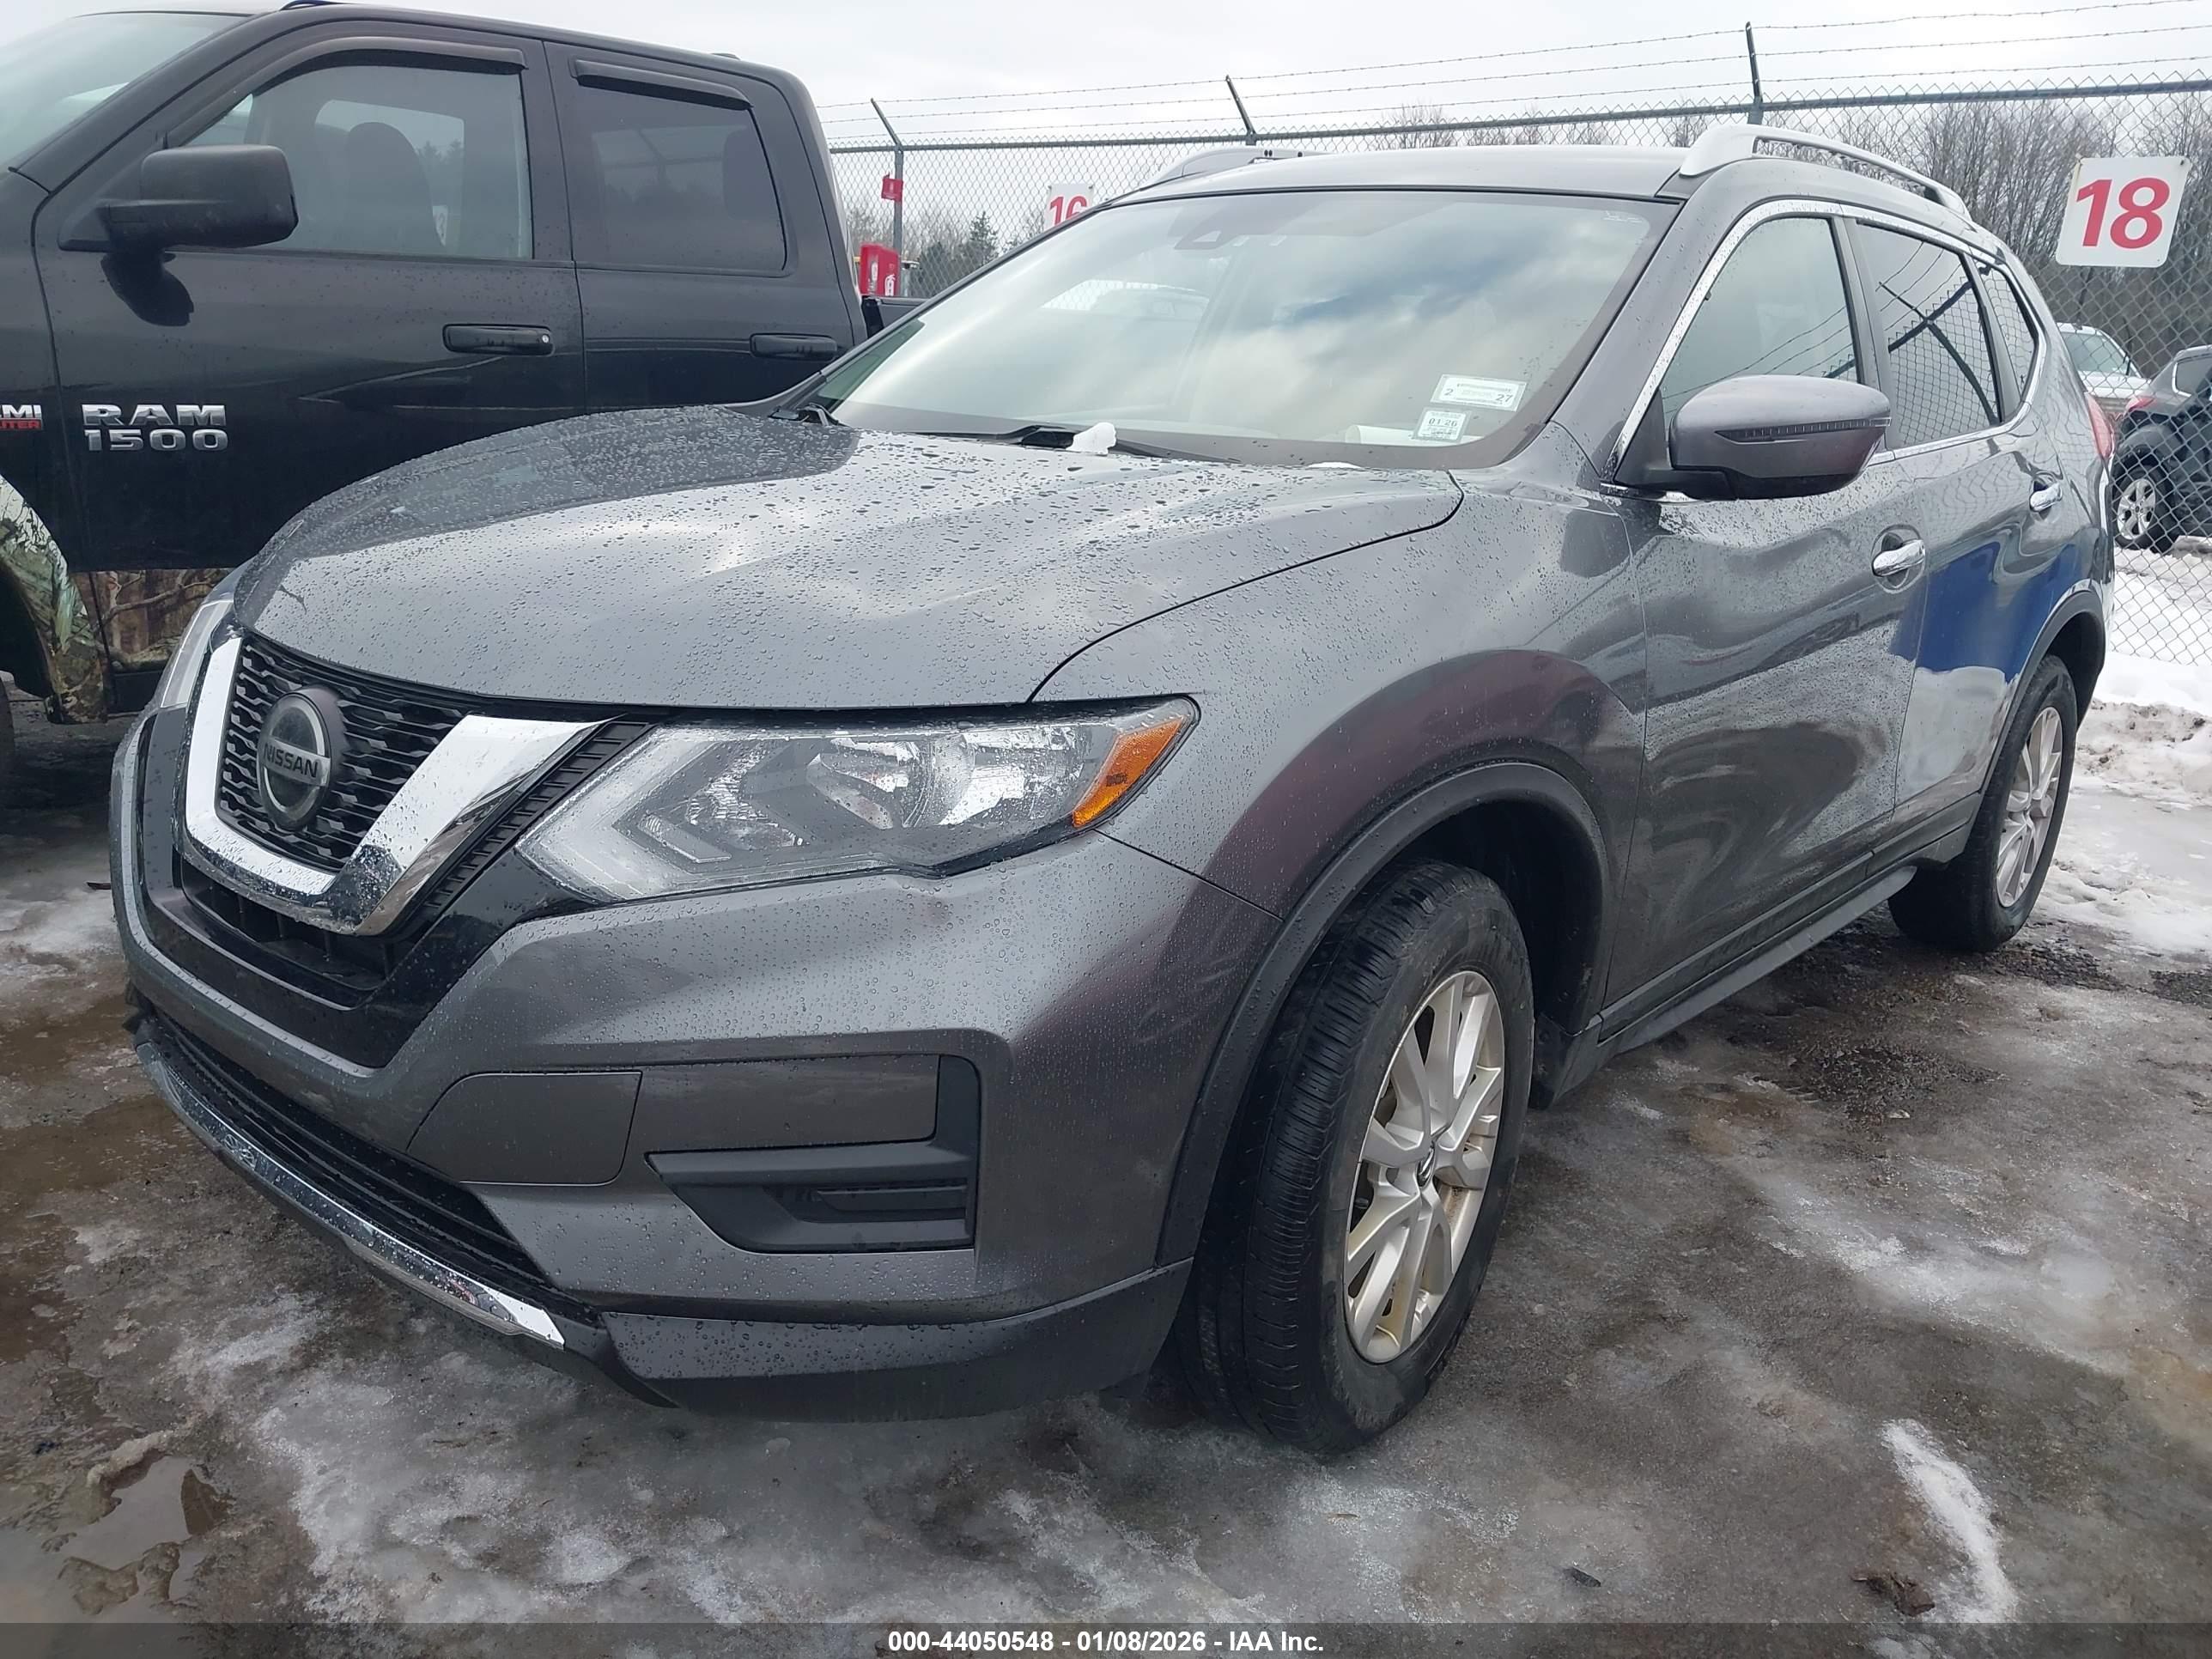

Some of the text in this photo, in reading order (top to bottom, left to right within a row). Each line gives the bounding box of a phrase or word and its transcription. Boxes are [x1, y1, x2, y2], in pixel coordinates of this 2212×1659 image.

[1049, 196, 1088, 226] 16
[2075, 177, 2171, 249] 18
[1495, 393, 1514, 404] 27
[82, 404, 226, 425] RAM
[84, 429, 228, 451] 1500
[263, 743, 319, 778] NISSAN
